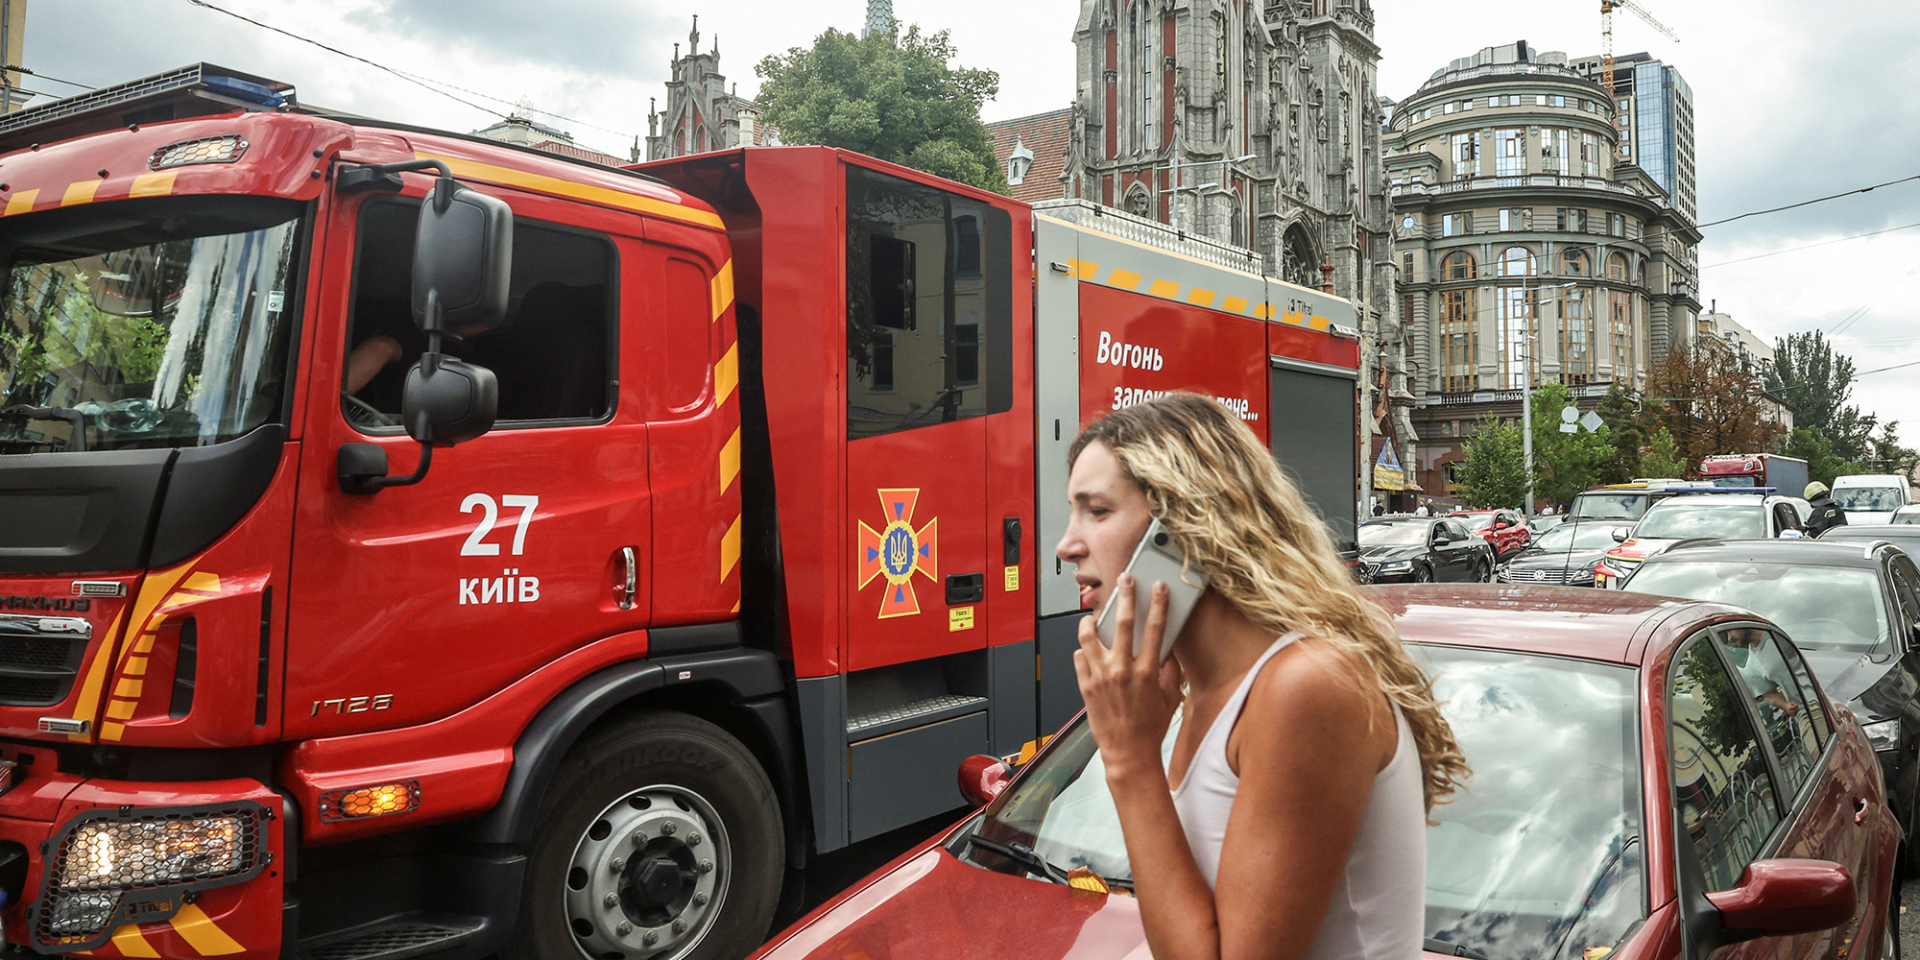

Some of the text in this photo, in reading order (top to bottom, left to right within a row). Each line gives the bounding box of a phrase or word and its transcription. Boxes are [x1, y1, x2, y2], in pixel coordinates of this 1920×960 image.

[1096, 330, 1164, 372] Вогонь
[459, 492, 539, 557] 27
[310, 694, 394, 717] 1728
